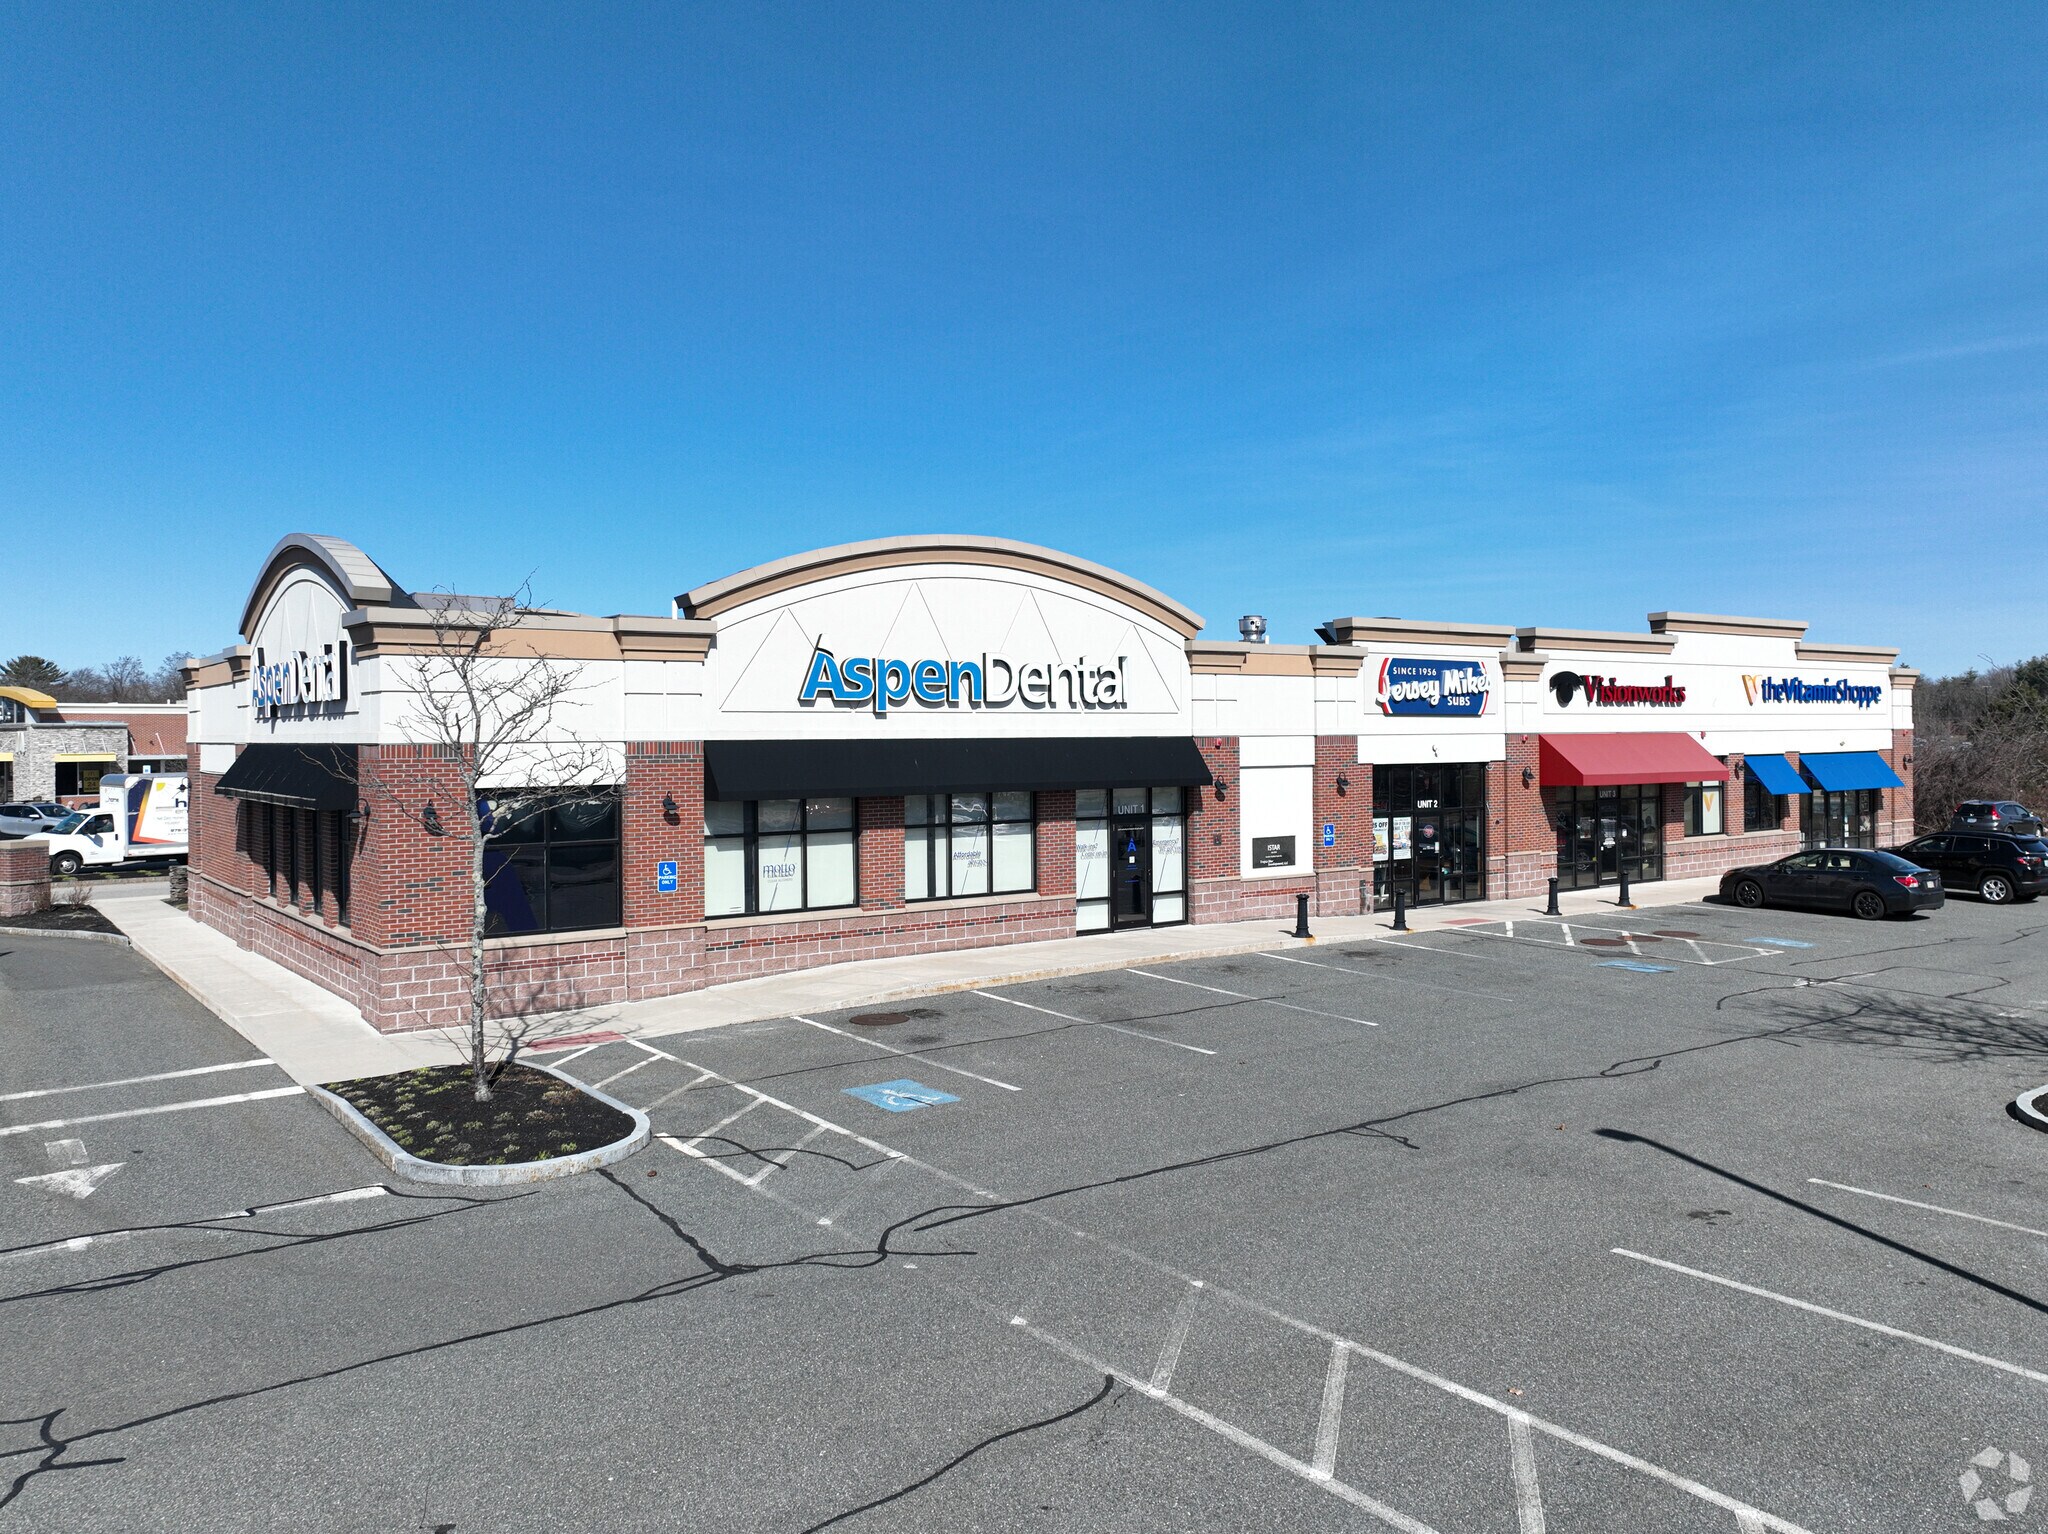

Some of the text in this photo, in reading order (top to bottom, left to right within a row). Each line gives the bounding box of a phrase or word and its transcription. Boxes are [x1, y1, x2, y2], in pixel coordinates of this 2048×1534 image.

[1392, 667, 1437, 676] SINCE 1956
[1376, 674, 1440, 706] Jersey
[1580, 675, 1687, 704] Visionworks
[1447, 696, 1471, 706] SUBS
[1118, 804, 1145, 814] UNIT 1
[1417, 800, 1438, 808] UNIT 2
